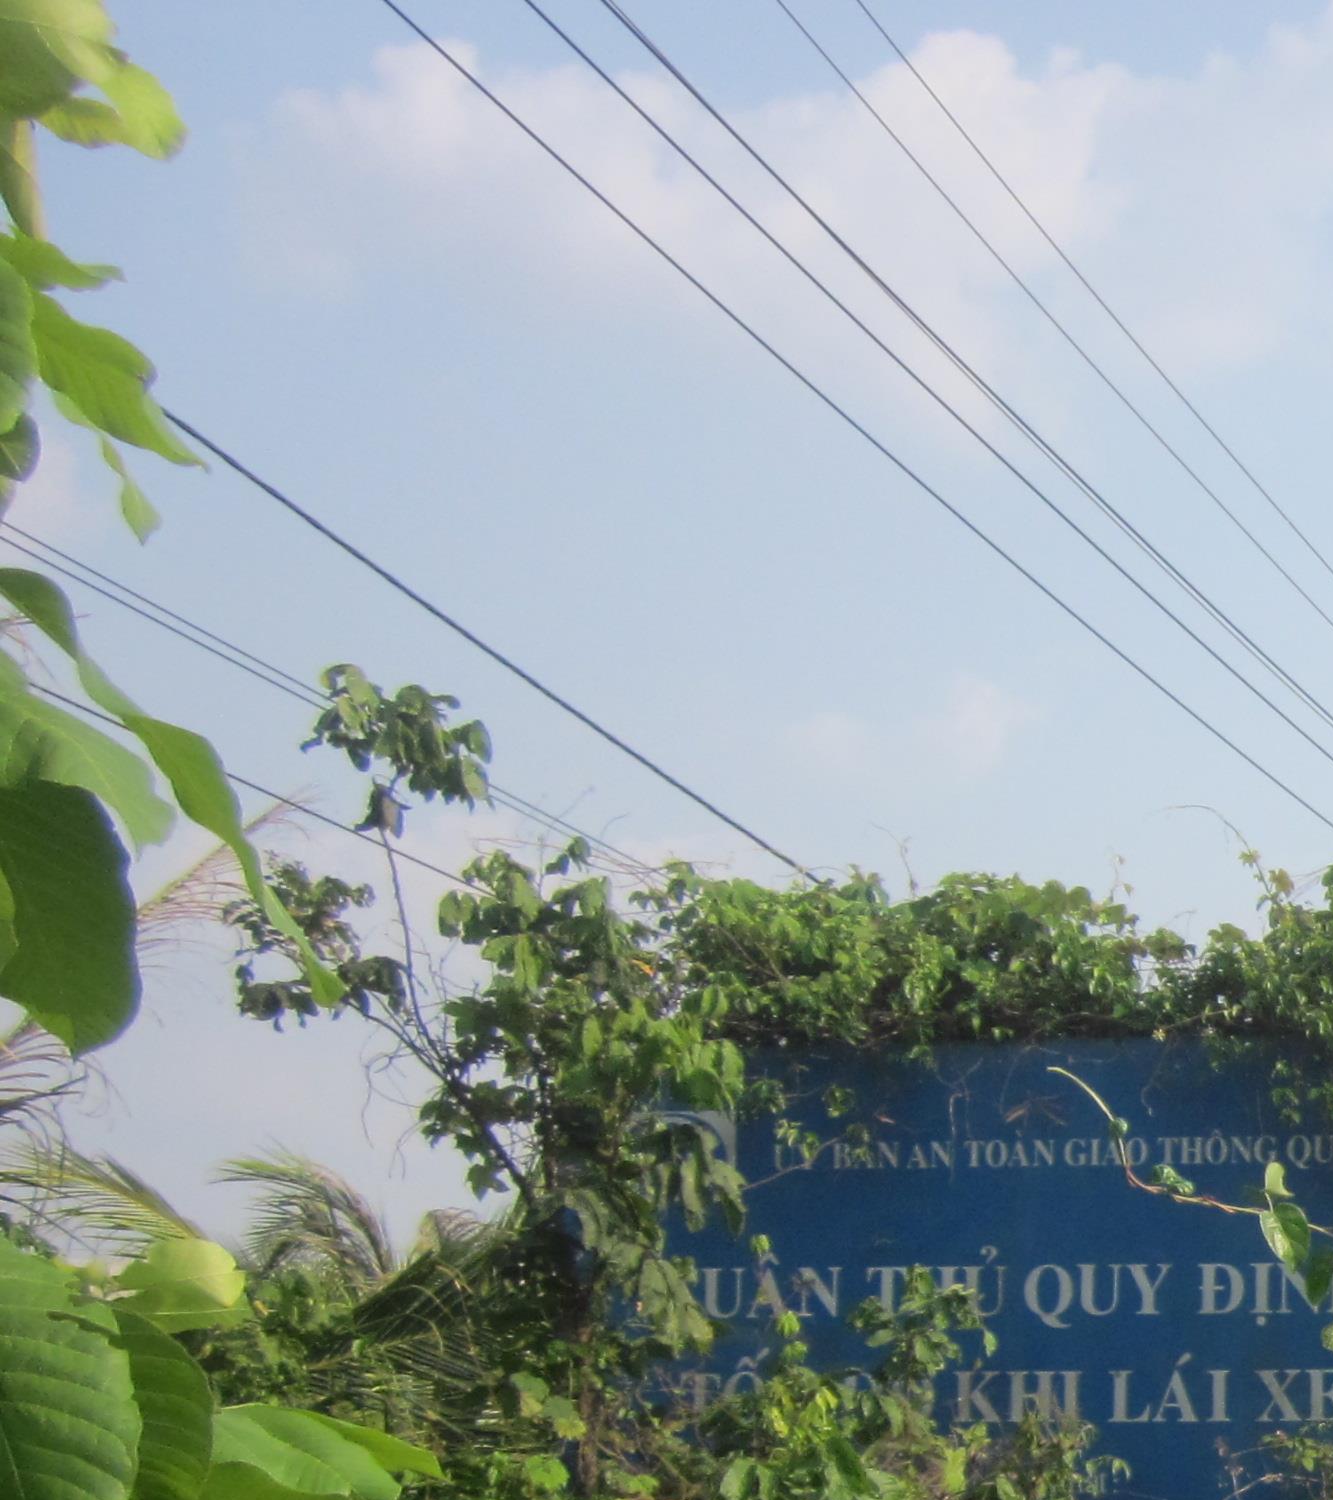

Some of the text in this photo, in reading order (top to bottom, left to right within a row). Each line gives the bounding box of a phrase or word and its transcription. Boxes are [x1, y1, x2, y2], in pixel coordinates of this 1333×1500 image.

[907, 1140, 951, 1169] AN
[963, 1130, 1056, 1168] TOÀN
[1064, 1137, 1148, 1168] GIAO
[1157, 1129, 1279, 1166] THÔNG
[698, 1252, 843, 1318] UÂN
[1023, 1262, 1173, 1328] QUY
[952, 1369, 1084, 1424] KHI
[1107, 1351, 1233, 1423] LÁI
